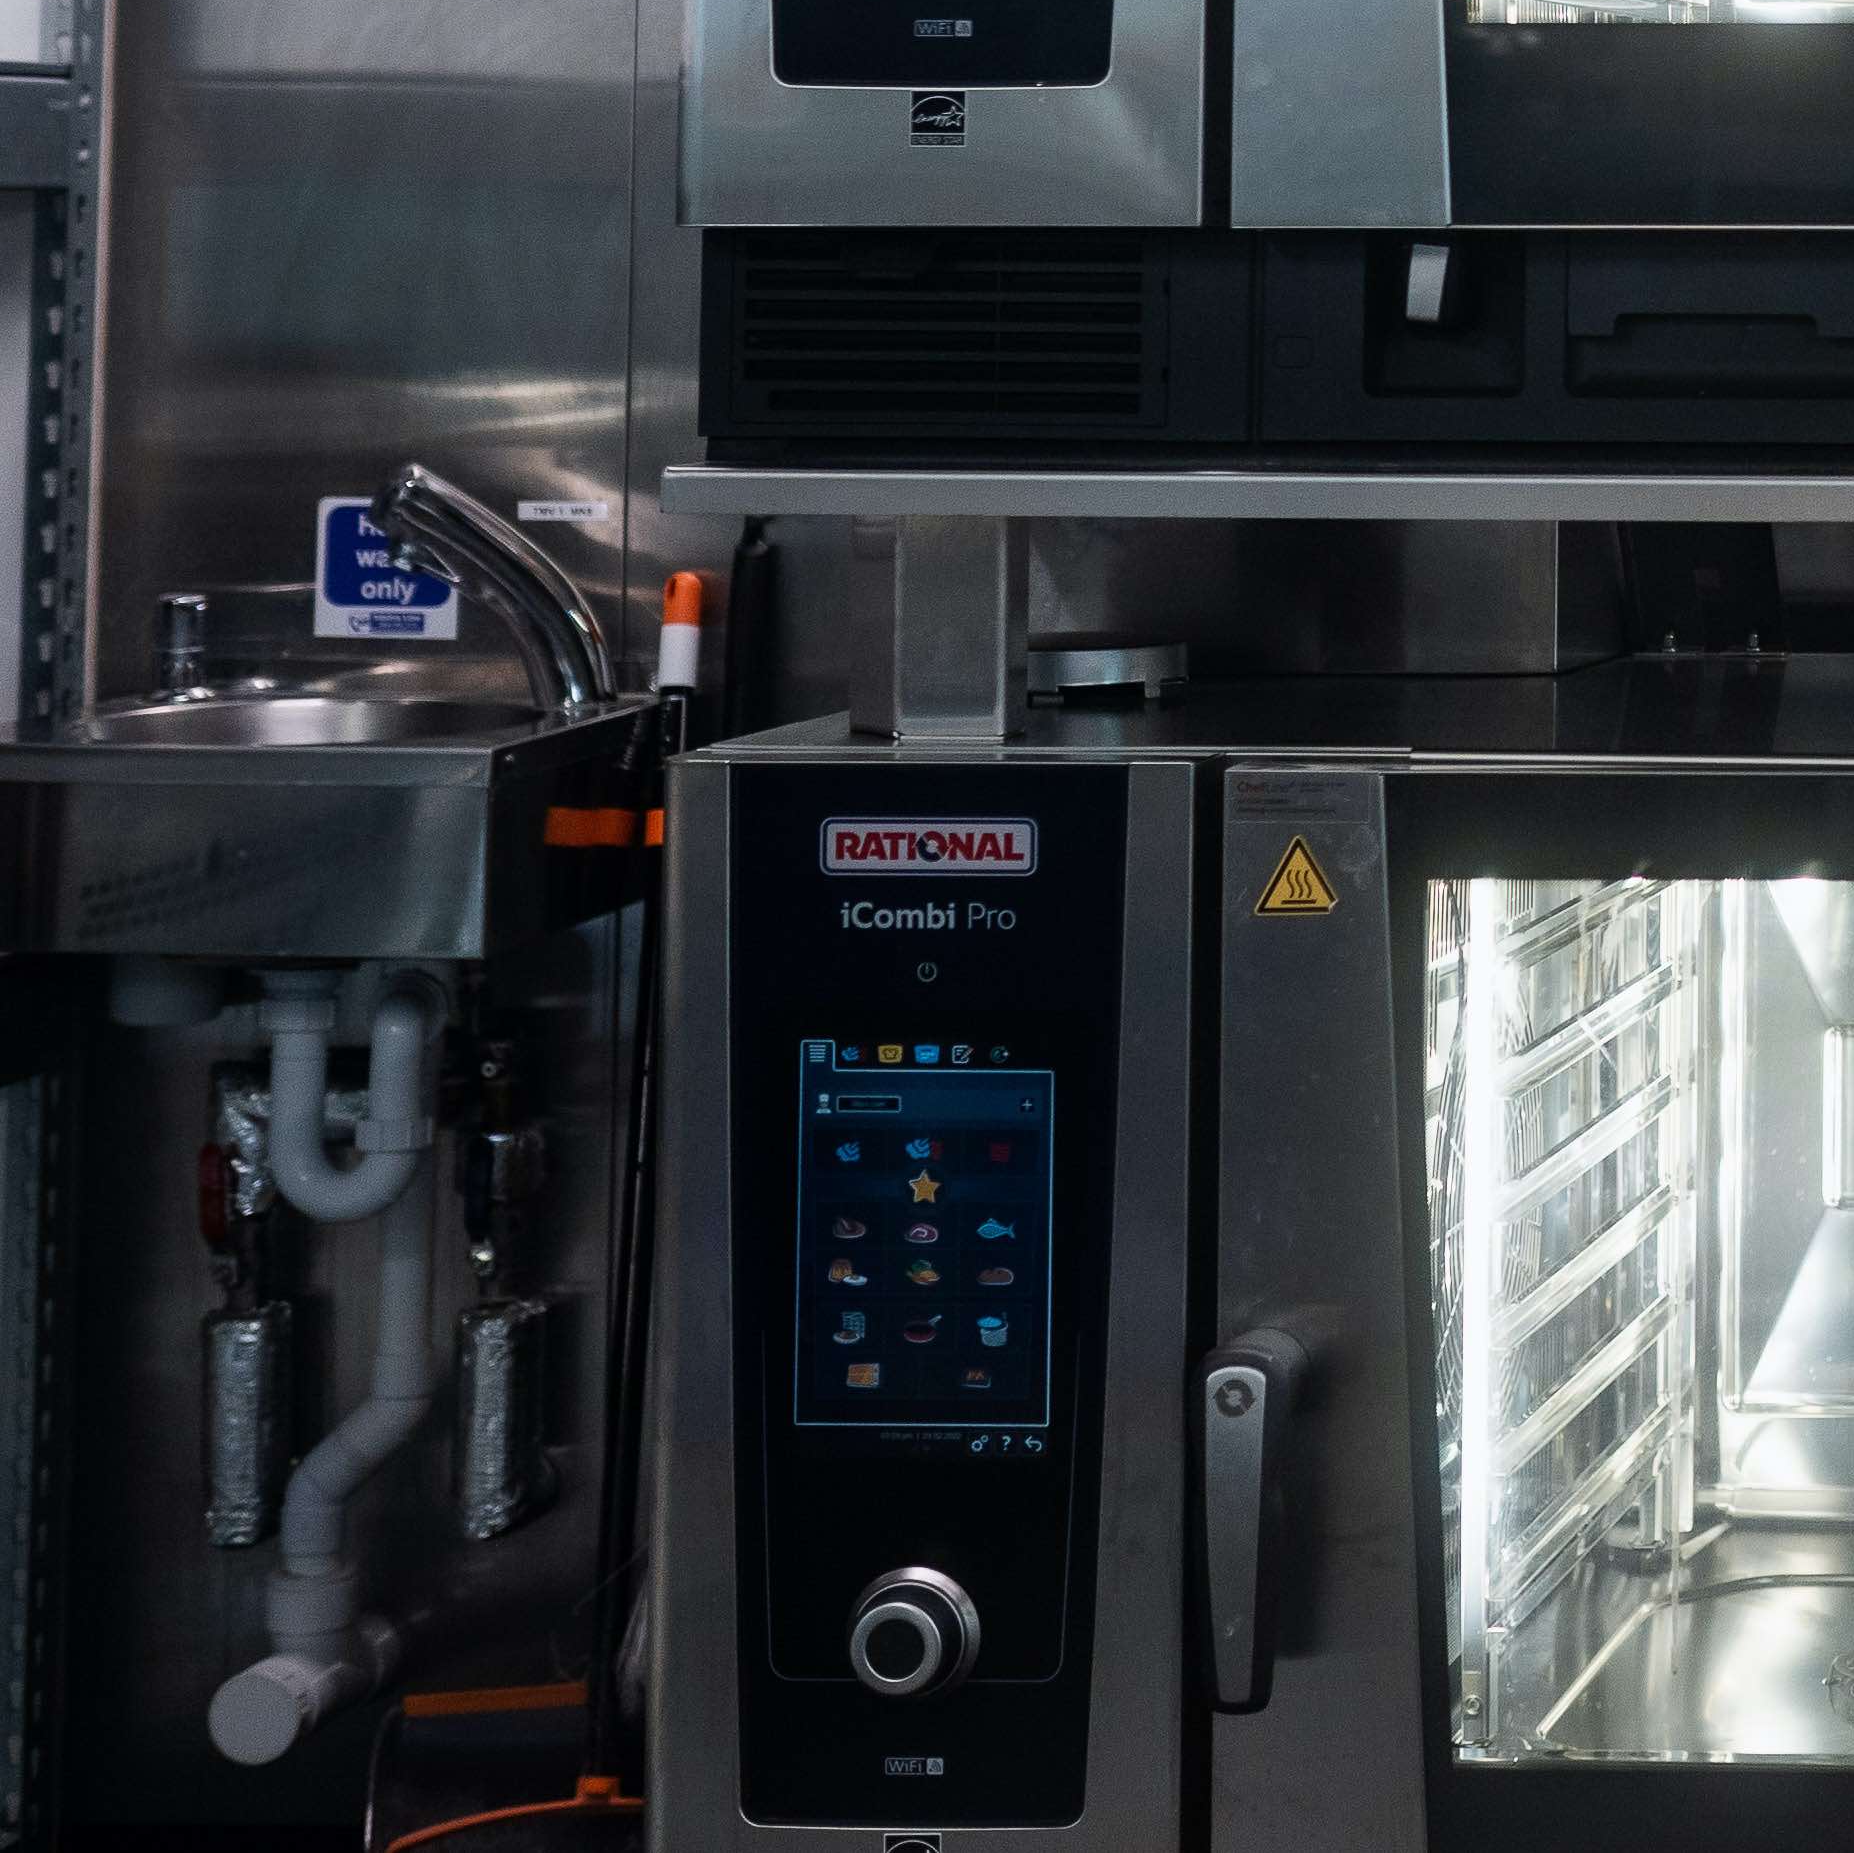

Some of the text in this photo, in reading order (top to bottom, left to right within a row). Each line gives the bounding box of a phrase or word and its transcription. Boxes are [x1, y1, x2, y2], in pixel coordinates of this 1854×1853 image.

[361, 577, 417, 605] only
[835, 831, 1024, 862] RATIONAL
[841, 901, 1017, 929] iCombi Pro
[886, 1759, 924, 1774] WiFi
